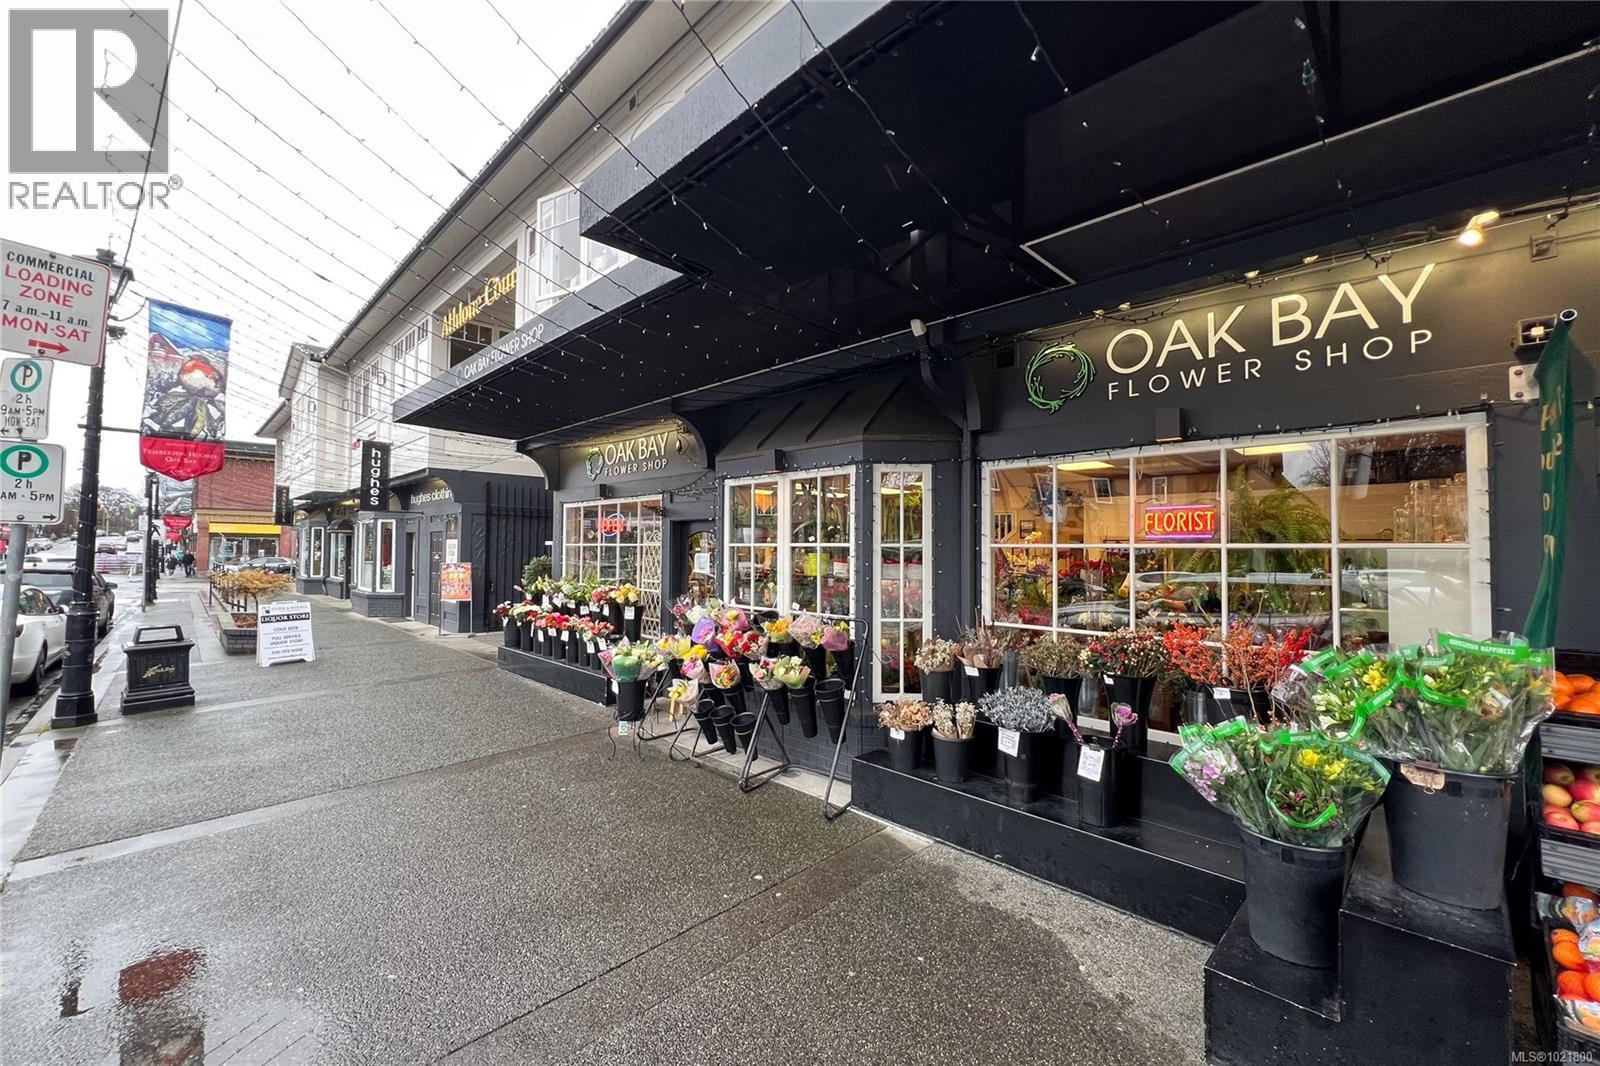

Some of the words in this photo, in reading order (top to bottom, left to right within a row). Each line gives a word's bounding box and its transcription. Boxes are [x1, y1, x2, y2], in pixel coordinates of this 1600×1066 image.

[5, 264, 93, 297] LOADING
[7, 251, 95, 282] COMMERCIAL
[2, 299, 10, 310] 7
[19, 284, 74, 308] ZONE
[1106, 304, 1246, 374] OAK
[1271, 264, 1436, 346] BAY
[464, 361, 478, 379] OAK
[478, 354, 491, 372] BAY
[490, 338, 520, 364] FLOWER
[521, 324, 544, 349] SHOP
[1108, 358, 1263, 400] FLOWER
[1295, 330, 1432, 371] SHOP
[604, 440, 636, 466] OAK
[639, 432, 669, 460] BAY
[370, 448, 382, 506] hughes
[604, 463, 638, 477] FLOWER
[643, 459, 668, 472] SHOP
[411, 492, 431, 506] hughes
[602, 518, 625, 532] OPEN
[1145, 510, 1215, 534] FLORIST
